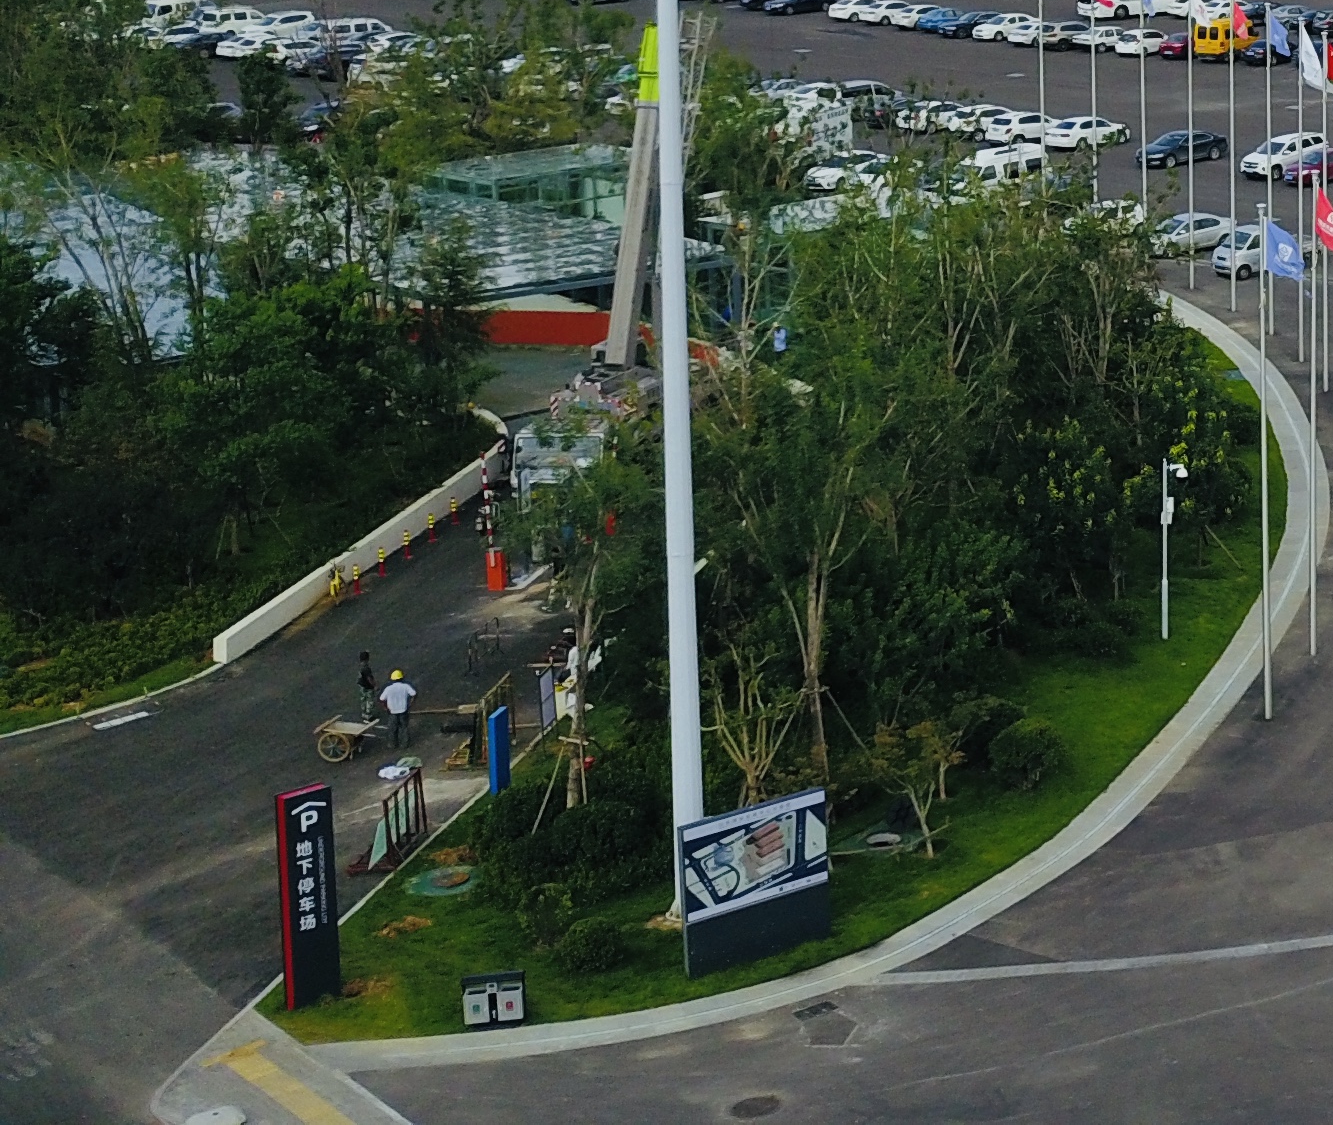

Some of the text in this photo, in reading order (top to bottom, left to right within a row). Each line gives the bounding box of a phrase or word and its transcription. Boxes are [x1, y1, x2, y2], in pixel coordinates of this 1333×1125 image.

[300, 810, 318, 833] P
[296, 840, 316, 931] 地下停车场
